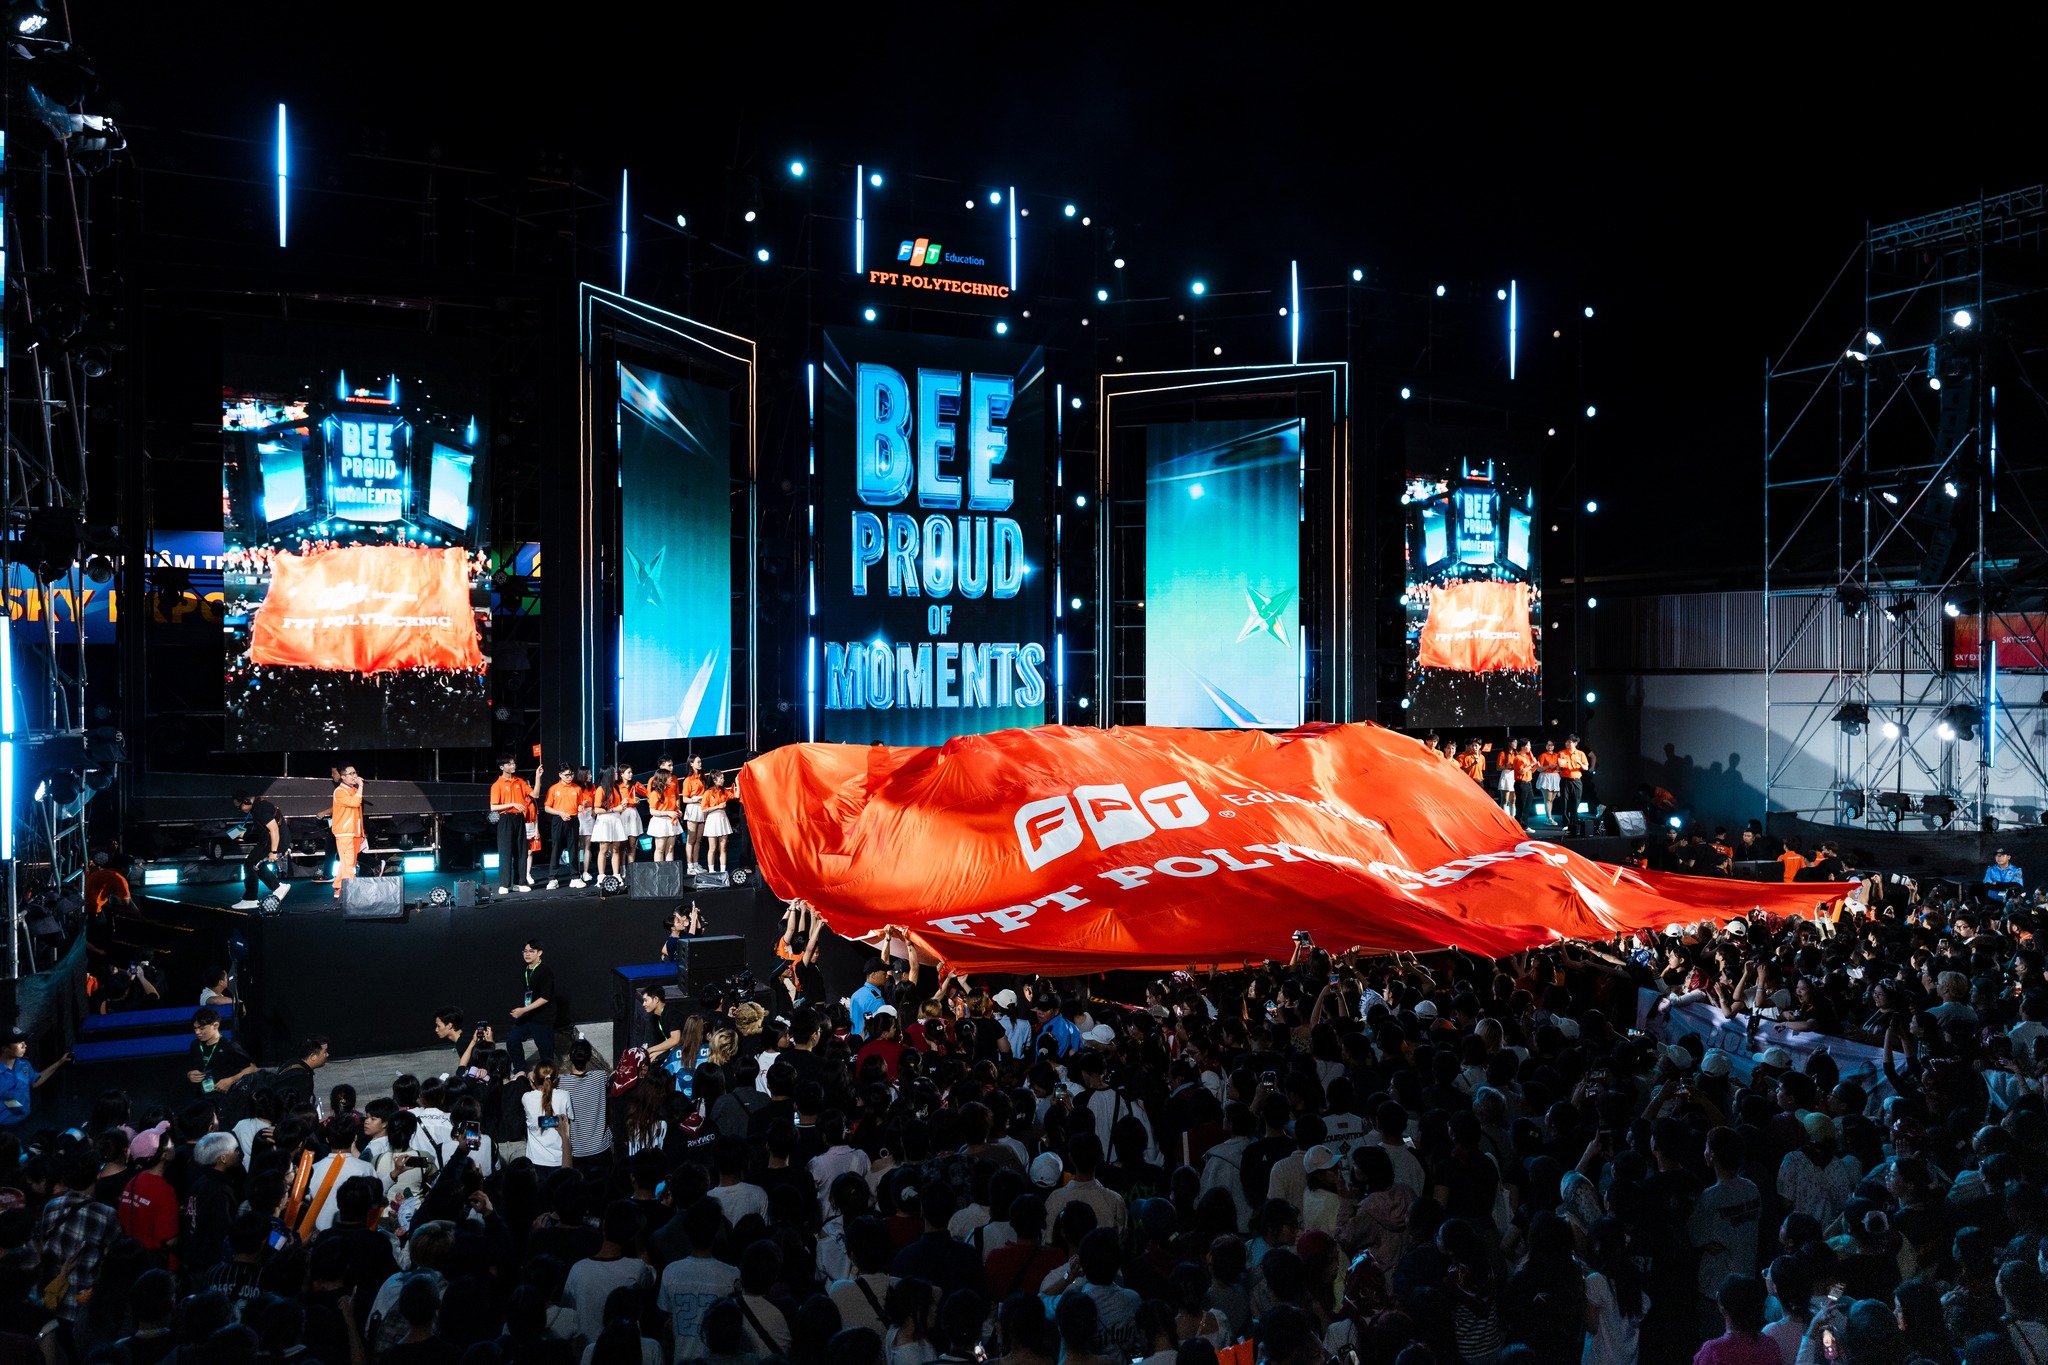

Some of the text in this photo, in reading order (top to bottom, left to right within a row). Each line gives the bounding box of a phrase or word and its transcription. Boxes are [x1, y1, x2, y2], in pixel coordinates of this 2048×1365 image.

[898, 239, 985, 266] FPT Education
[869, 271, 1009, 298] FPT POLYTECHNIC
[342, 421, 394, 458] BEE
[856, 362, 1015, 511] BEE
[341, 457, 397, 479] PROUD
[852, 510, 1024, 599] PROUD
[927, 605, 953, 637] OF
[825, 642, 1046, 711] MOMENTS
[1015, 782, 1208, 871] FPT
[927, 885, 1090, 937] FPT
